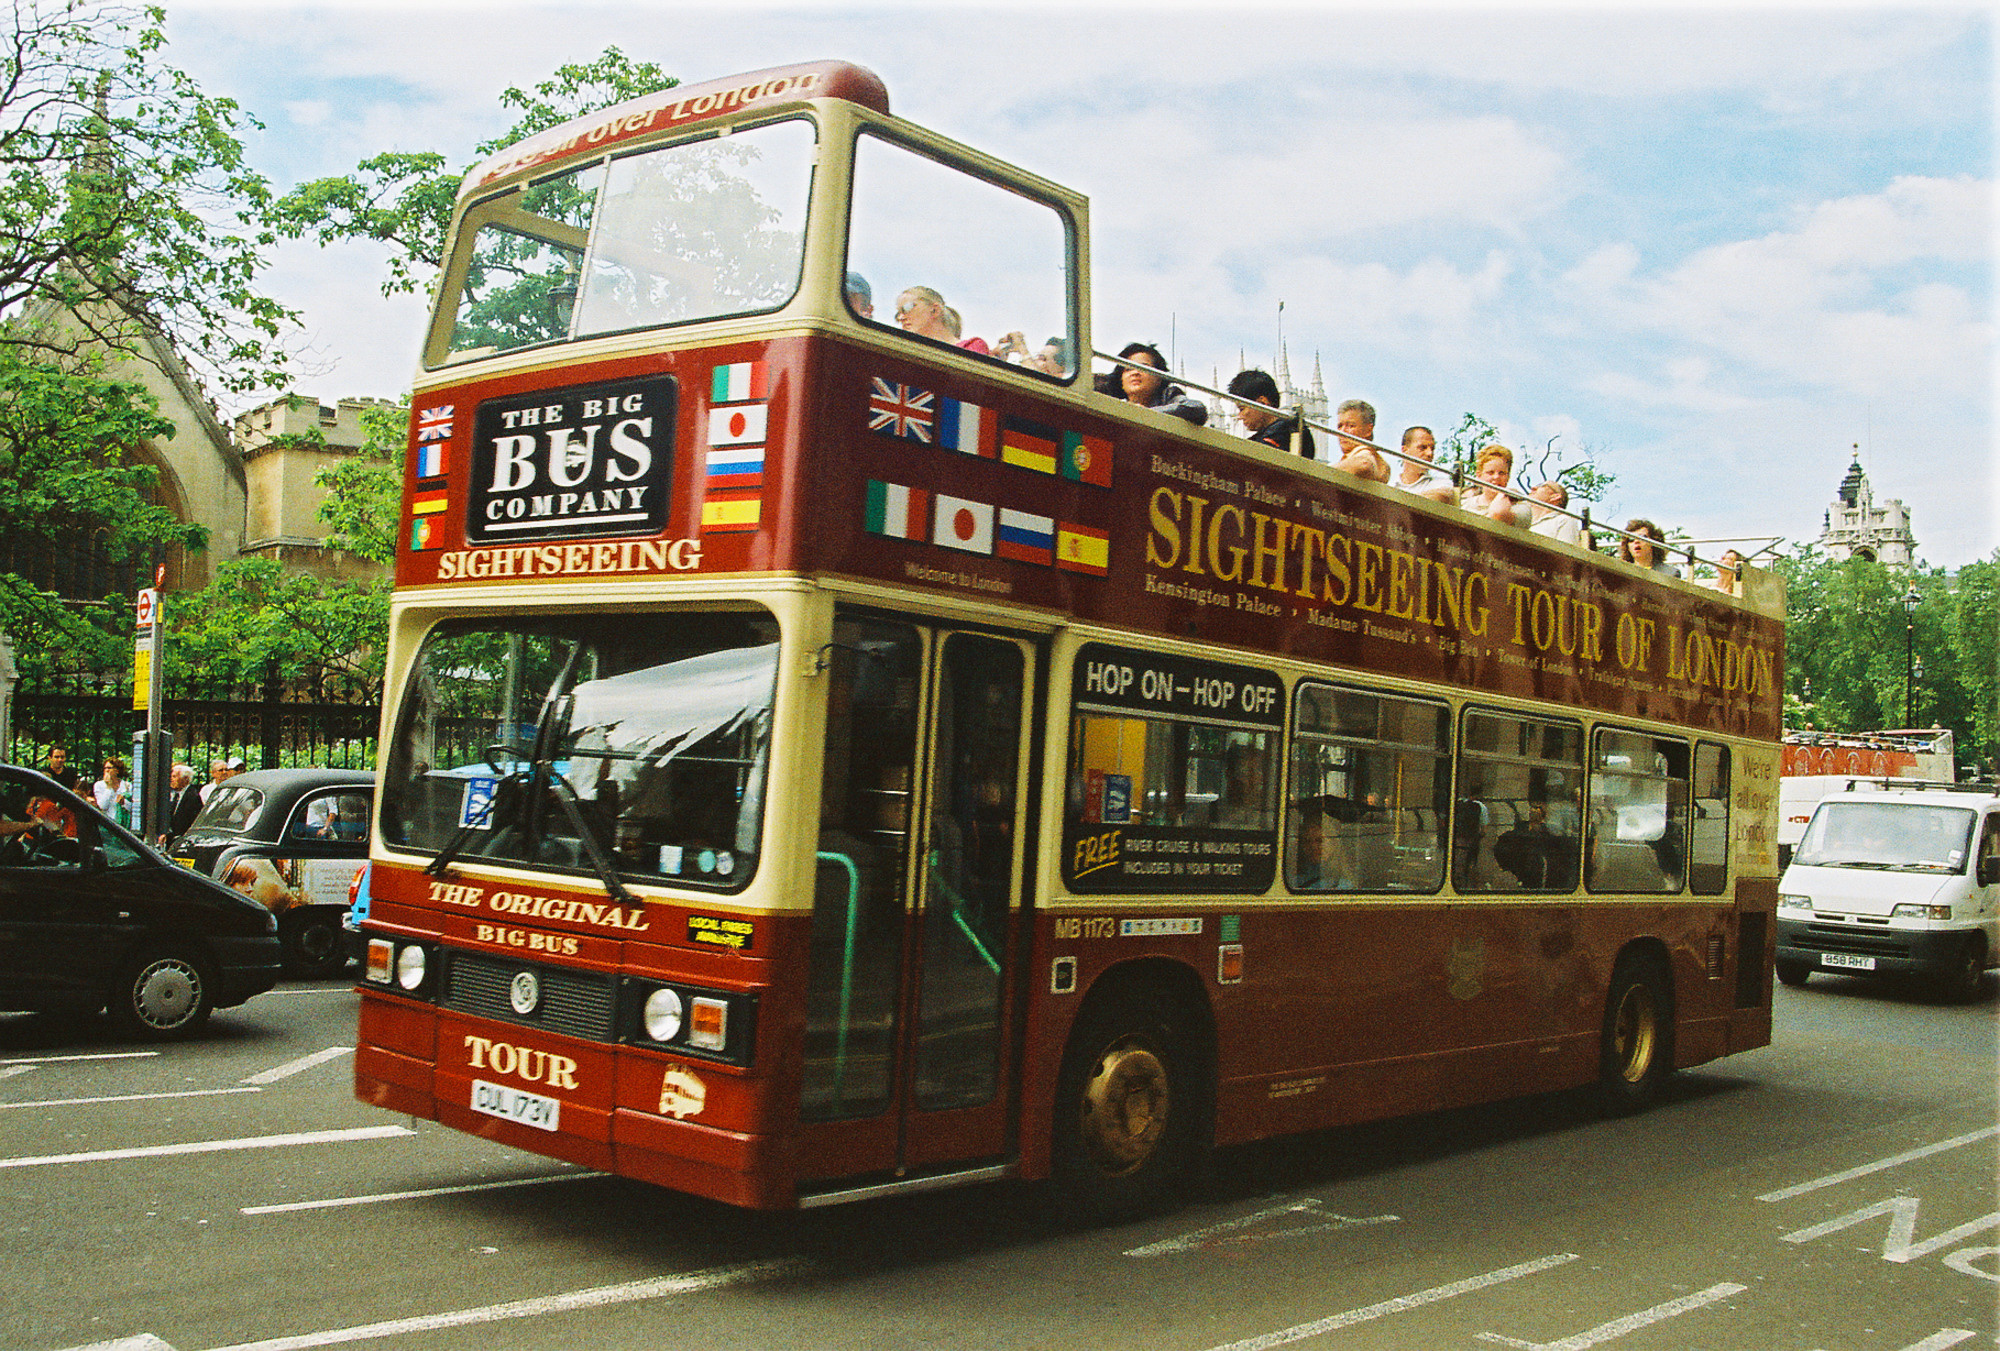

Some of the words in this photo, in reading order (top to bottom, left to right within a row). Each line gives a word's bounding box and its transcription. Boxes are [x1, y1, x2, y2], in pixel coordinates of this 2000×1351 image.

[587, 108, 661, 143] over
[671, 70, 821, 120] London
[502, 404, 563, 429] THE
[582, 394, 643, 420] BIG
[487, 417, 652, 493] BUS
[1151, 454, 1239, 495] Buckingham
[1244, 481, 1286, 507] Palace
[485, 486, 649, 520] COMPANY
[437, 539, 704, 580] SIGHTSEEING
[1145, 573, 1230, 609] Kensington
[1237, 592, 1282, 617] Palace
[1307, 608, 1359, 633] Madame
[1146, 487, 1491, 638] SIGHTSEEING
[1507, 583, 1603, 662] TOUR
[1616, 613, 1655, 672] OF
[1666, 624, 1775, 697] LONDON
[1086, 661, 1134, 695] HOP
[1241, 684, 1276, 714] OFF
[1073, 830, 1121, 871] FREE
[1155, 839, 1190, 853] CRUISE
[1242, 842, 1271, 856] TOURS
[428, 882, 483, 907] THE
[489, 891, 650, 931] ORIGINAL
[476, 924, 526, 947] BIG
[528, 931, 579, 955] BUS
[464, 1035, 579, 1089] TOUR
